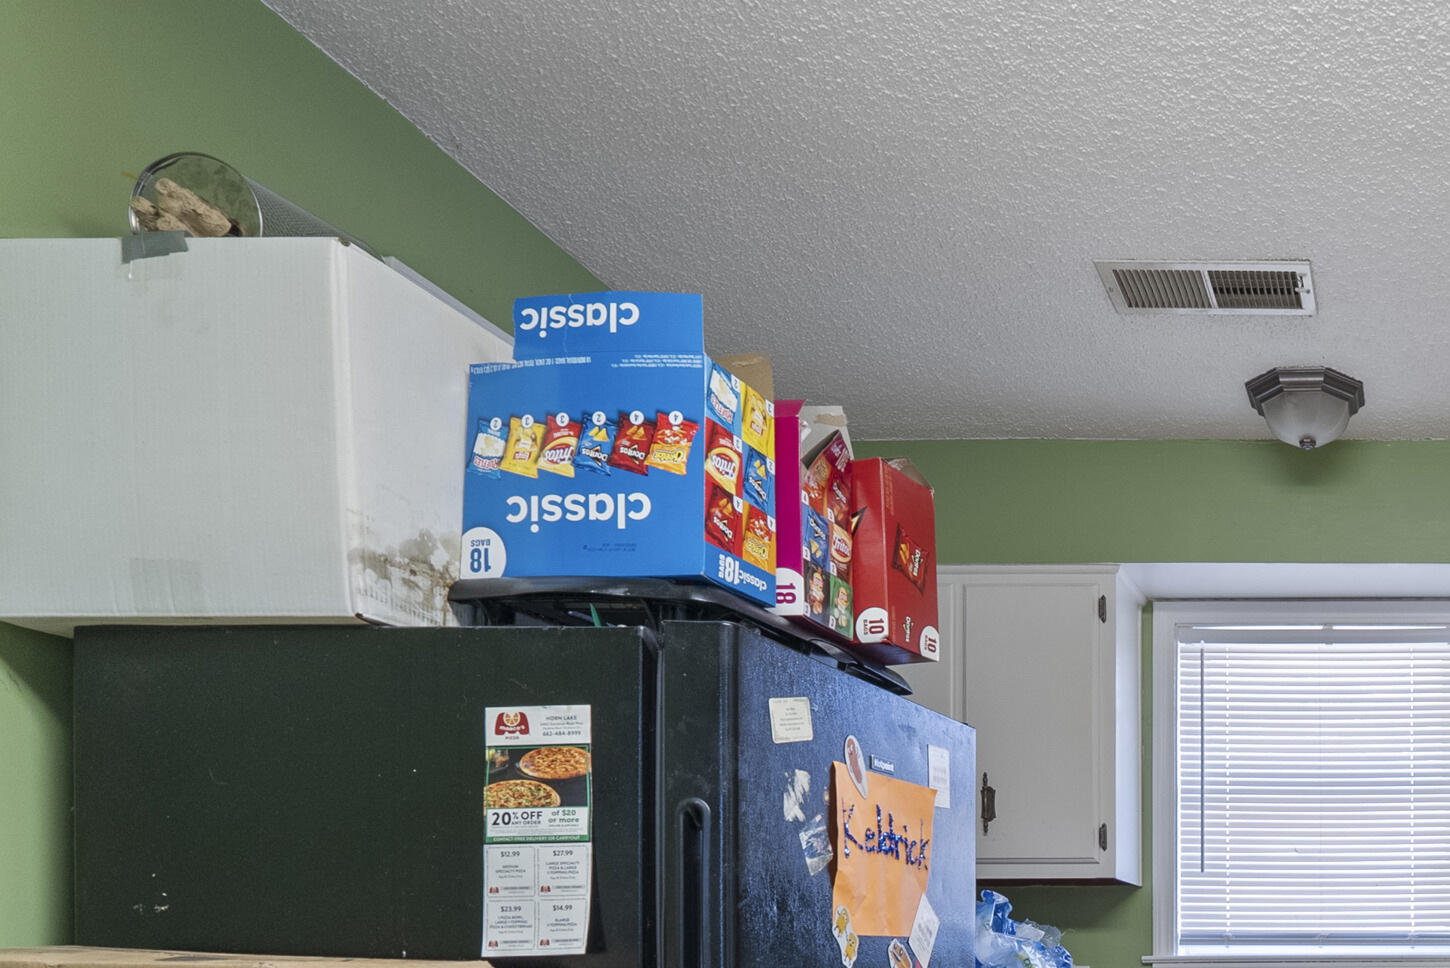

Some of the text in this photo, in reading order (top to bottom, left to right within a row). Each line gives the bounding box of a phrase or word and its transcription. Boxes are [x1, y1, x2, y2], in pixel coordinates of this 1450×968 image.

[520, 302, 640, 338] classic
[543, 445, 574, 463] Fritos
[582, 446, 608, 462] Doritos
[619, 445, 645, 462] Doritos
[711, 452, 737, 480] Fritos
[505, 492, 651, 534] classic
[470, 539, 491, 547] BAGS
[470, 552, 491, 573] 18
[725, 556, 767, 593] classic 18
[776, 582, 797, 604] 18
[869, 618, 884, 634] 10
[927, 636, 937, 653] 10
[521, 811, 543, 820] OFF
